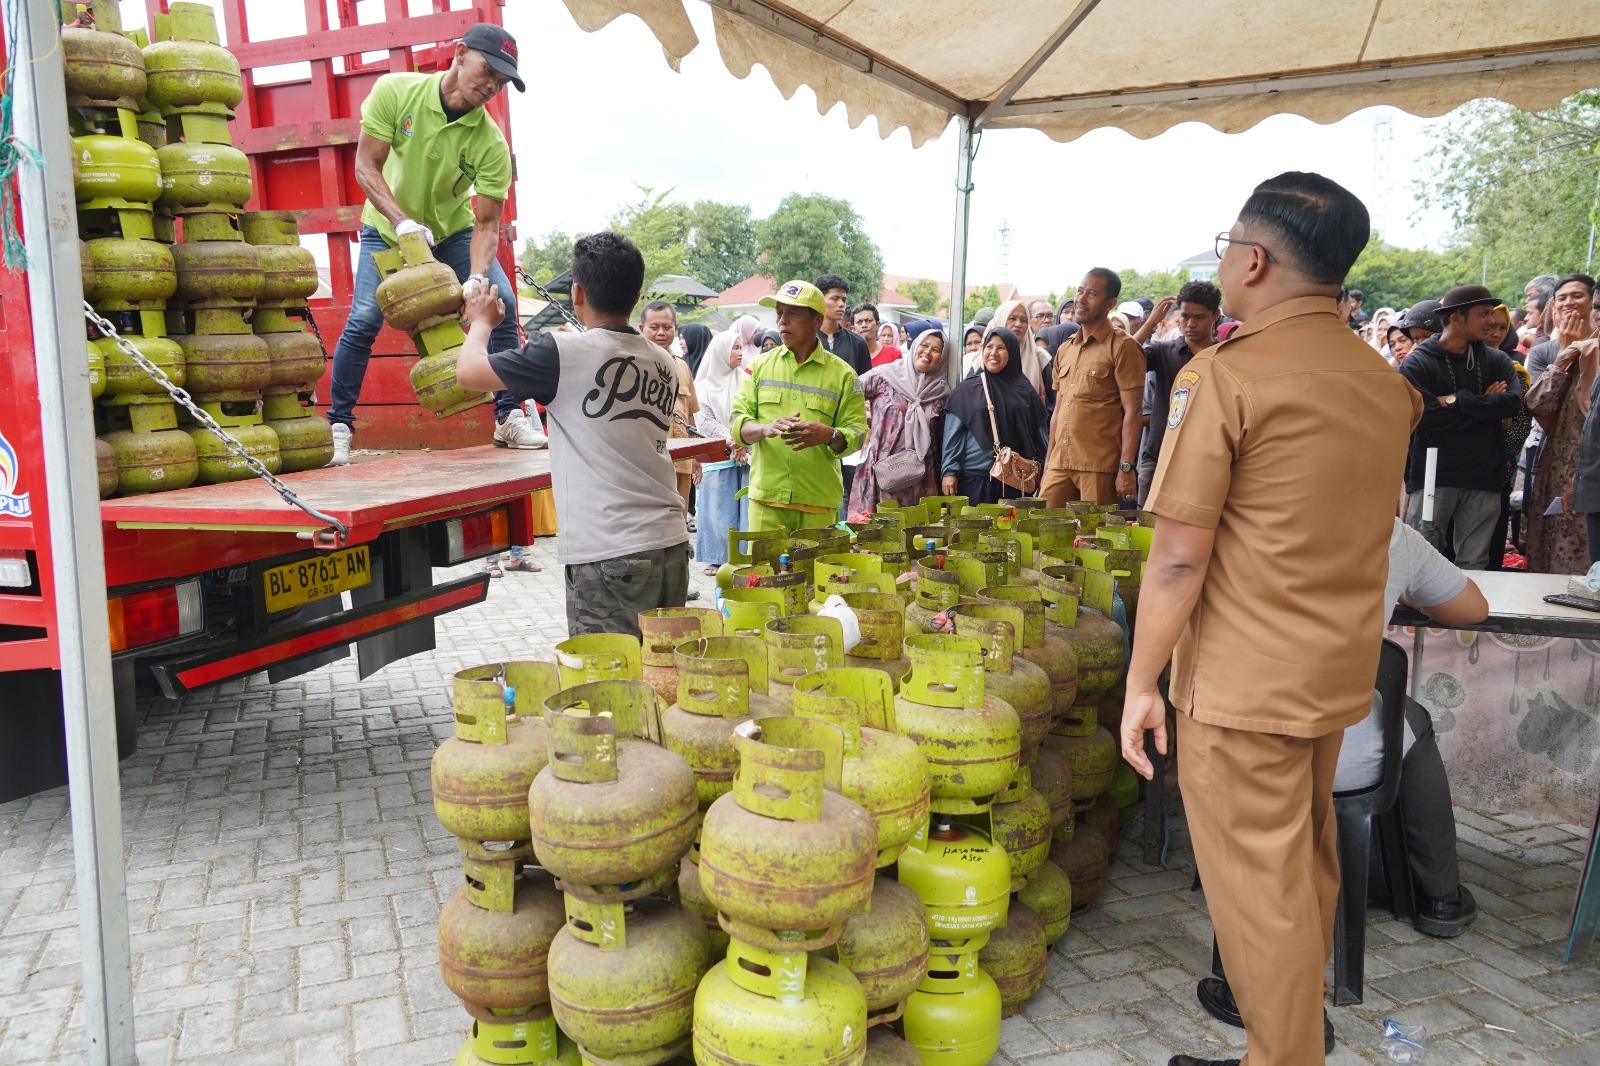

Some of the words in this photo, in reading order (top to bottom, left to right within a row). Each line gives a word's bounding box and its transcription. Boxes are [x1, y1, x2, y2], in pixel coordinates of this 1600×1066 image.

[581, 355, 679, 418] Plein
[269, 570, 292, 597] BL
[298, 557, 340, 588] 8761
[346, 550, 367, 576] AN
